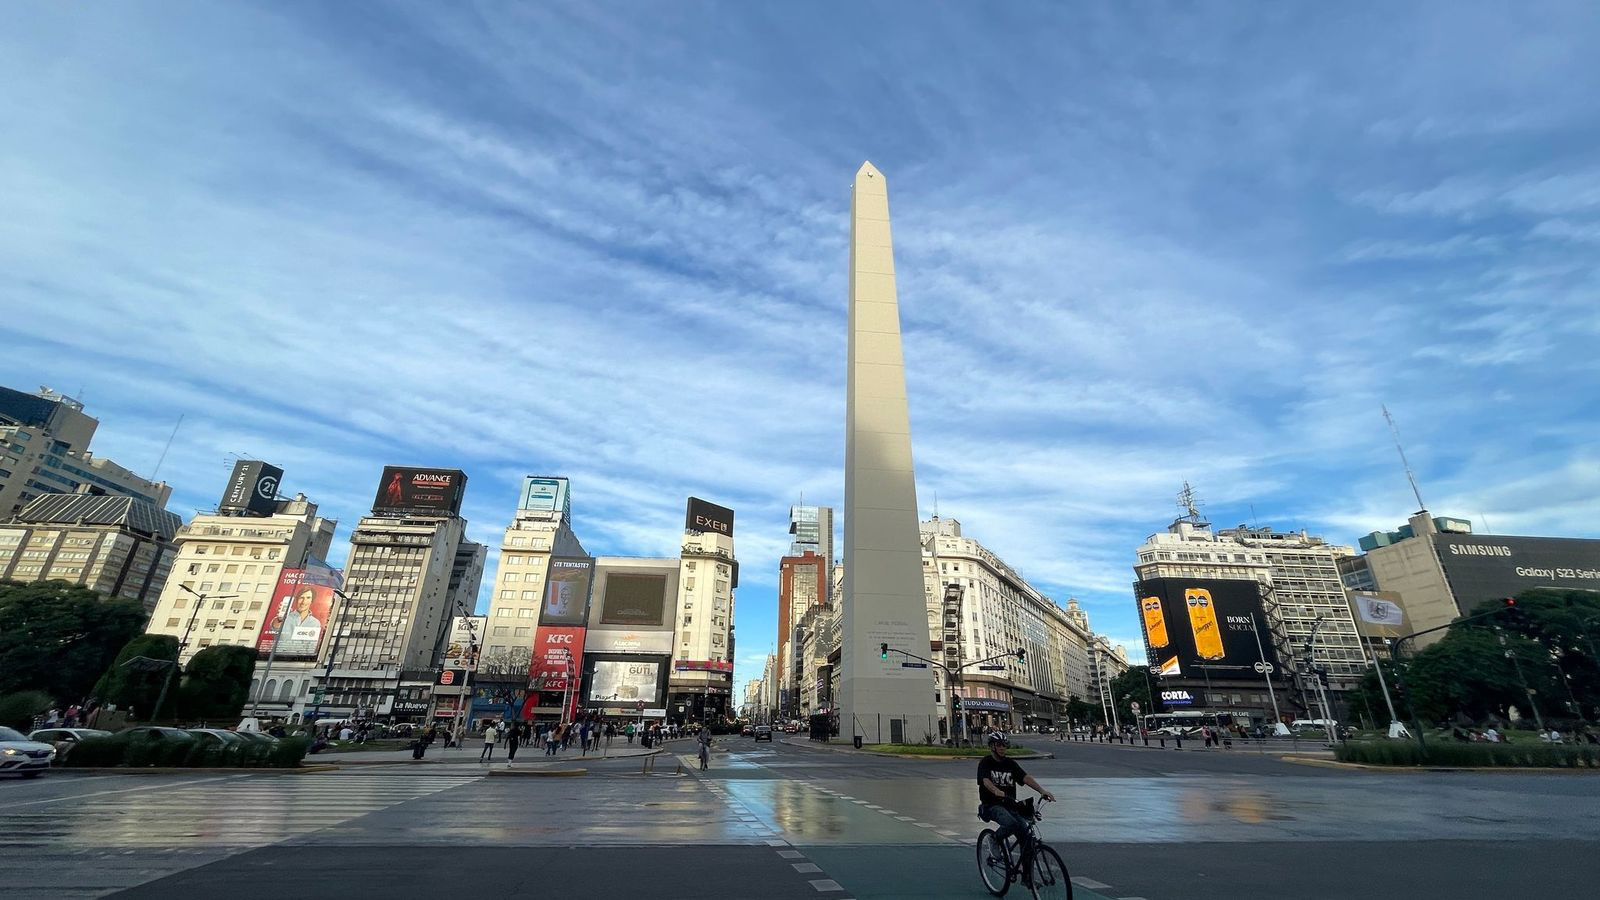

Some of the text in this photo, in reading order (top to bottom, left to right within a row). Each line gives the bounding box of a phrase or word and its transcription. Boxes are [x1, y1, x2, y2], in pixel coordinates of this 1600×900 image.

[413, 473, 451, 482] ADVANCE
[230, 471, 246, 502] CENTURY
[1449, 544, 1511, 557] SAMSUNG
[1515, 566, 1555, 580] Galaxy
[1556, 568, 1576, 578] S23
[1226, 615, 1251, 624] BORN
[546, 634, 574, 644] KFC
[545, 680, 564, 688] KFC
[1161, 690, 1190, 700] CORTA
[991, 770, 1013, 785] NYC
